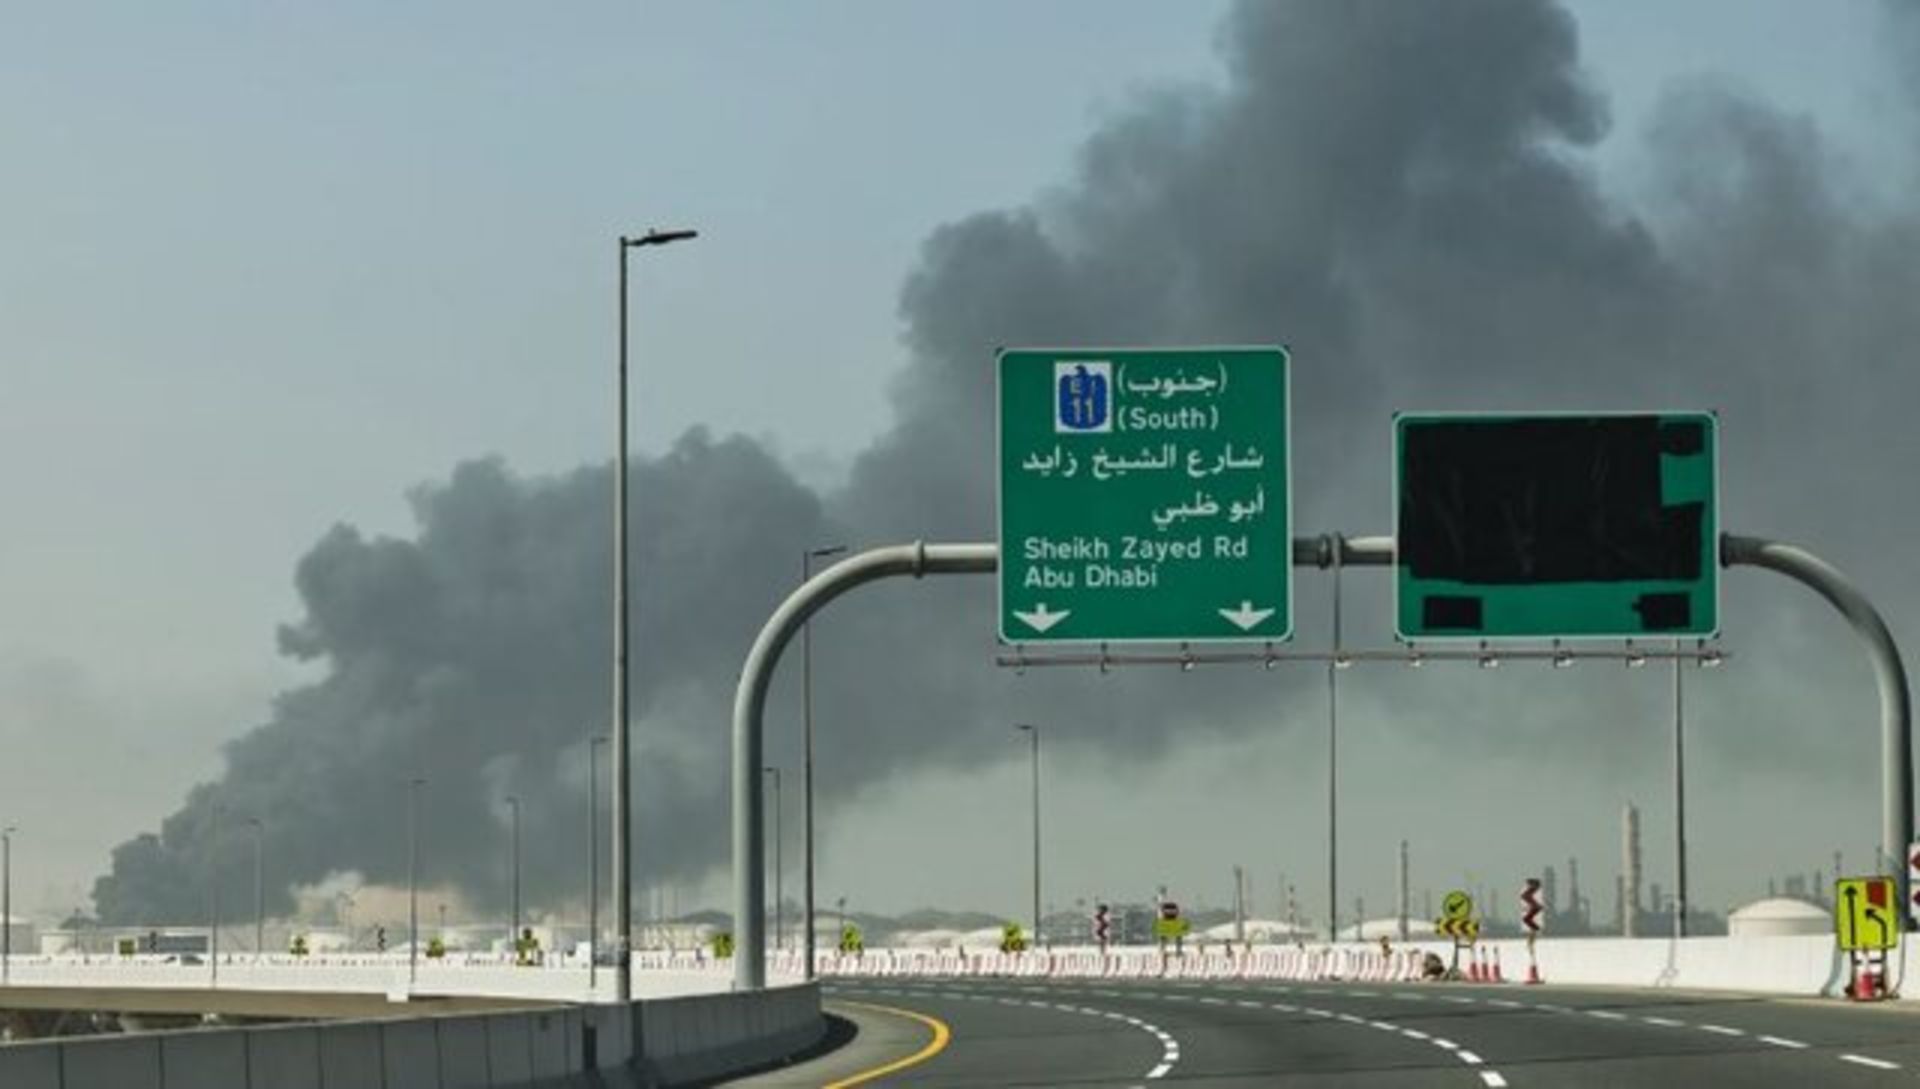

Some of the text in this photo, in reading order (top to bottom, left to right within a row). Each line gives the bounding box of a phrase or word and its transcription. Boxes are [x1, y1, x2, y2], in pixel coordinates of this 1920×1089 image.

[1070, 379, 1081, 395] E
[1072, 397, 1094, 423] 11
[1118, 404, 1219, 431] (South)
[1022, 443, 1264, 480] شارع الشيخ زايد
[1152, 483, 1265, 531] أبو ظبي
[1024, 536, 1248, 562] Sheikh Zayed Rd
[1024, 564, 1158, 588] Abu Dhabi
